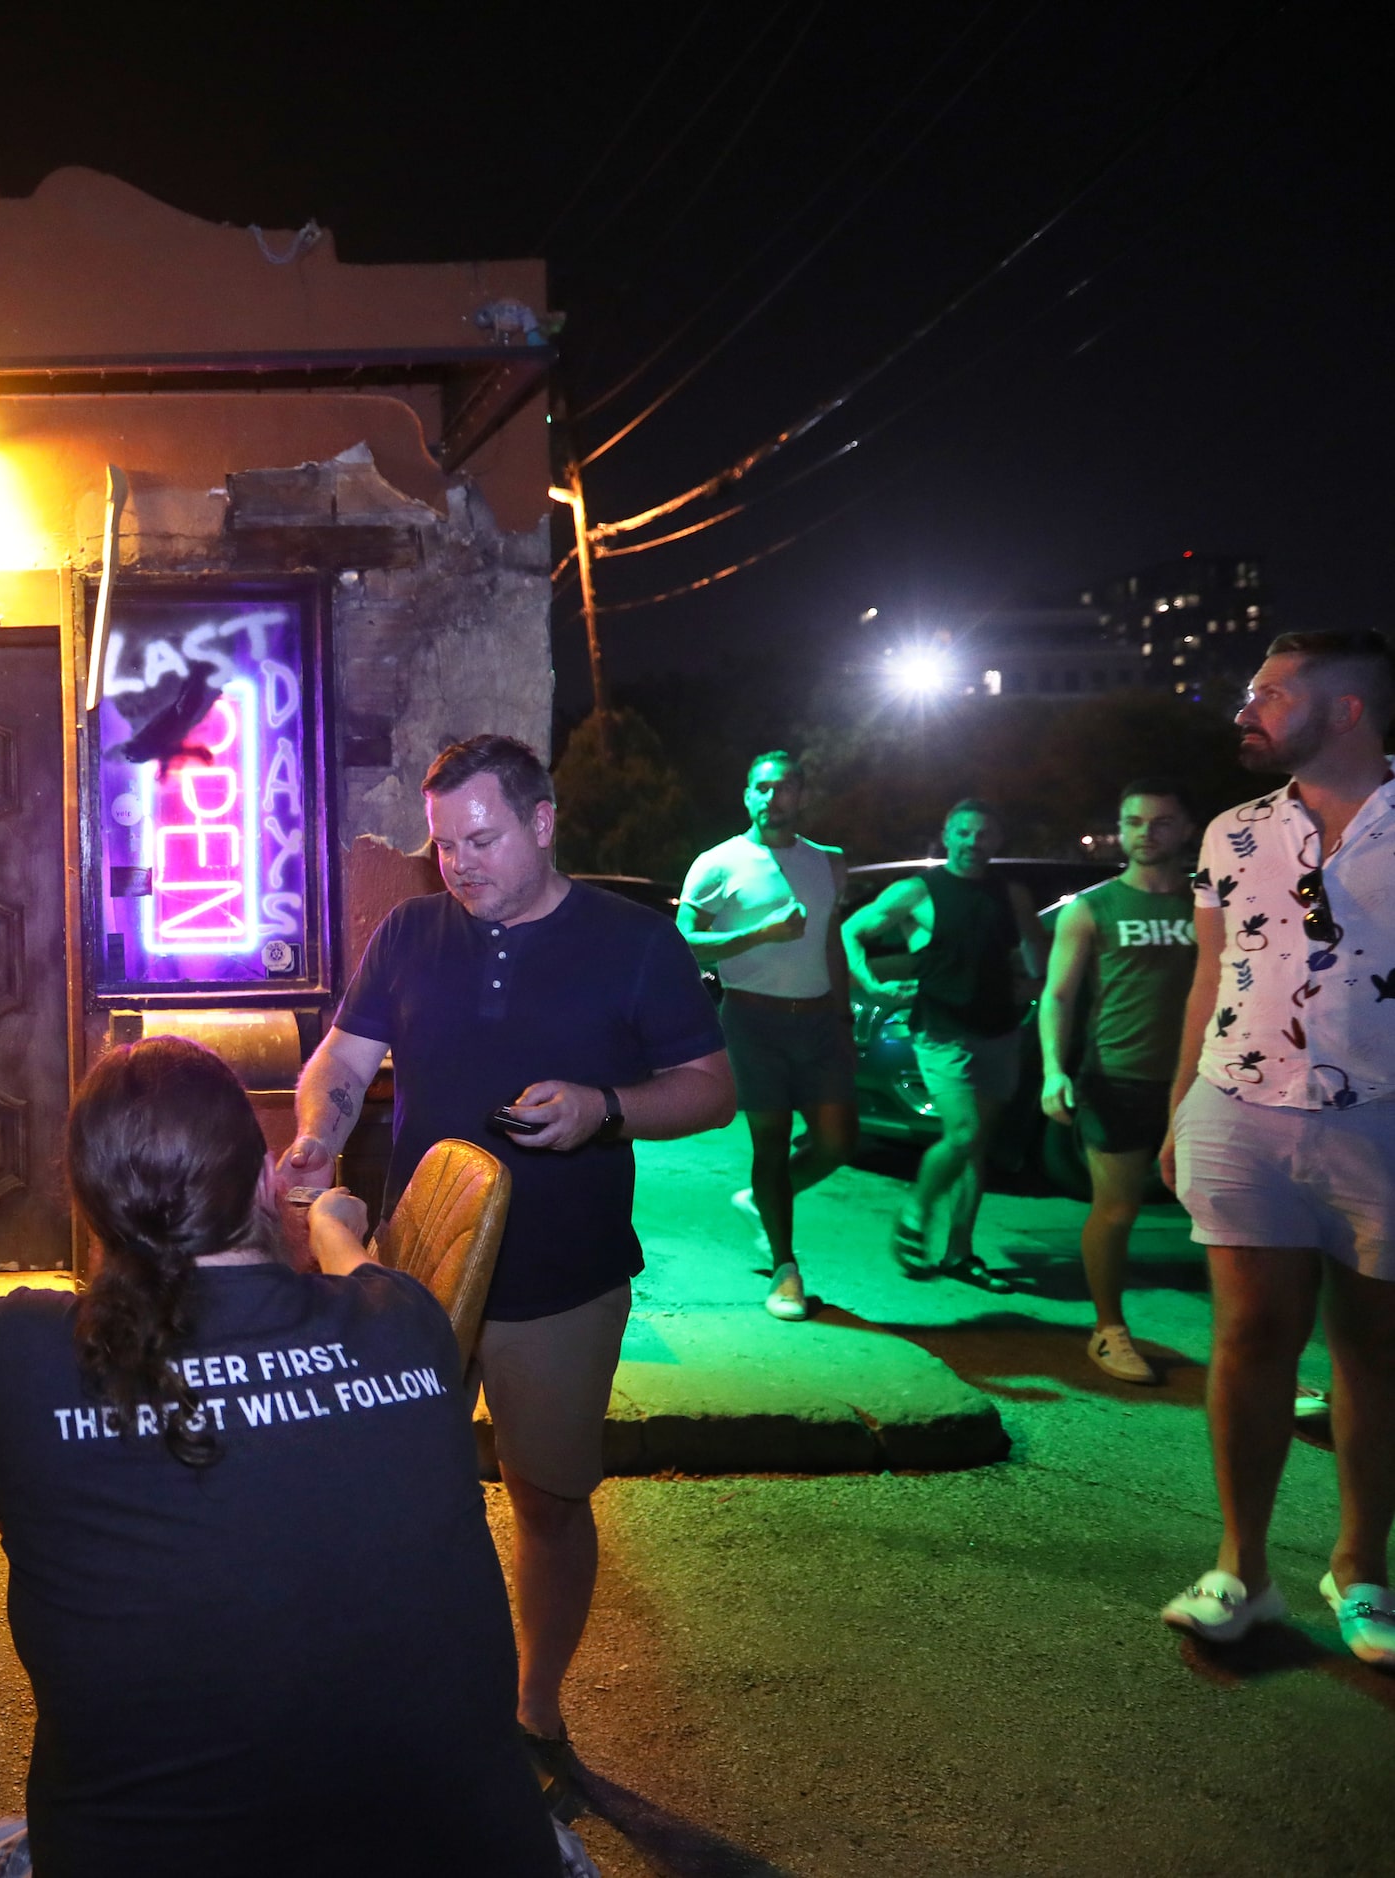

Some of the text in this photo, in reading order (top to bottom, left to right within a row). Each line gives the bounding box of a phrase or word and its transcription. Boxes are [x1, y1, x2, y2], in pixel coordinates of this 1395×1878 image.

[103, 610, 288, 697] LAST
[258, 659, 303, 936] DAYS
[53, 1407, 120, 1440] THE
[237, 1386, 330, 1427] WILL
[334, 1367, 447, 1412] FOLLOW.
[166, 1342, 359, 1387] EER FIRST.
